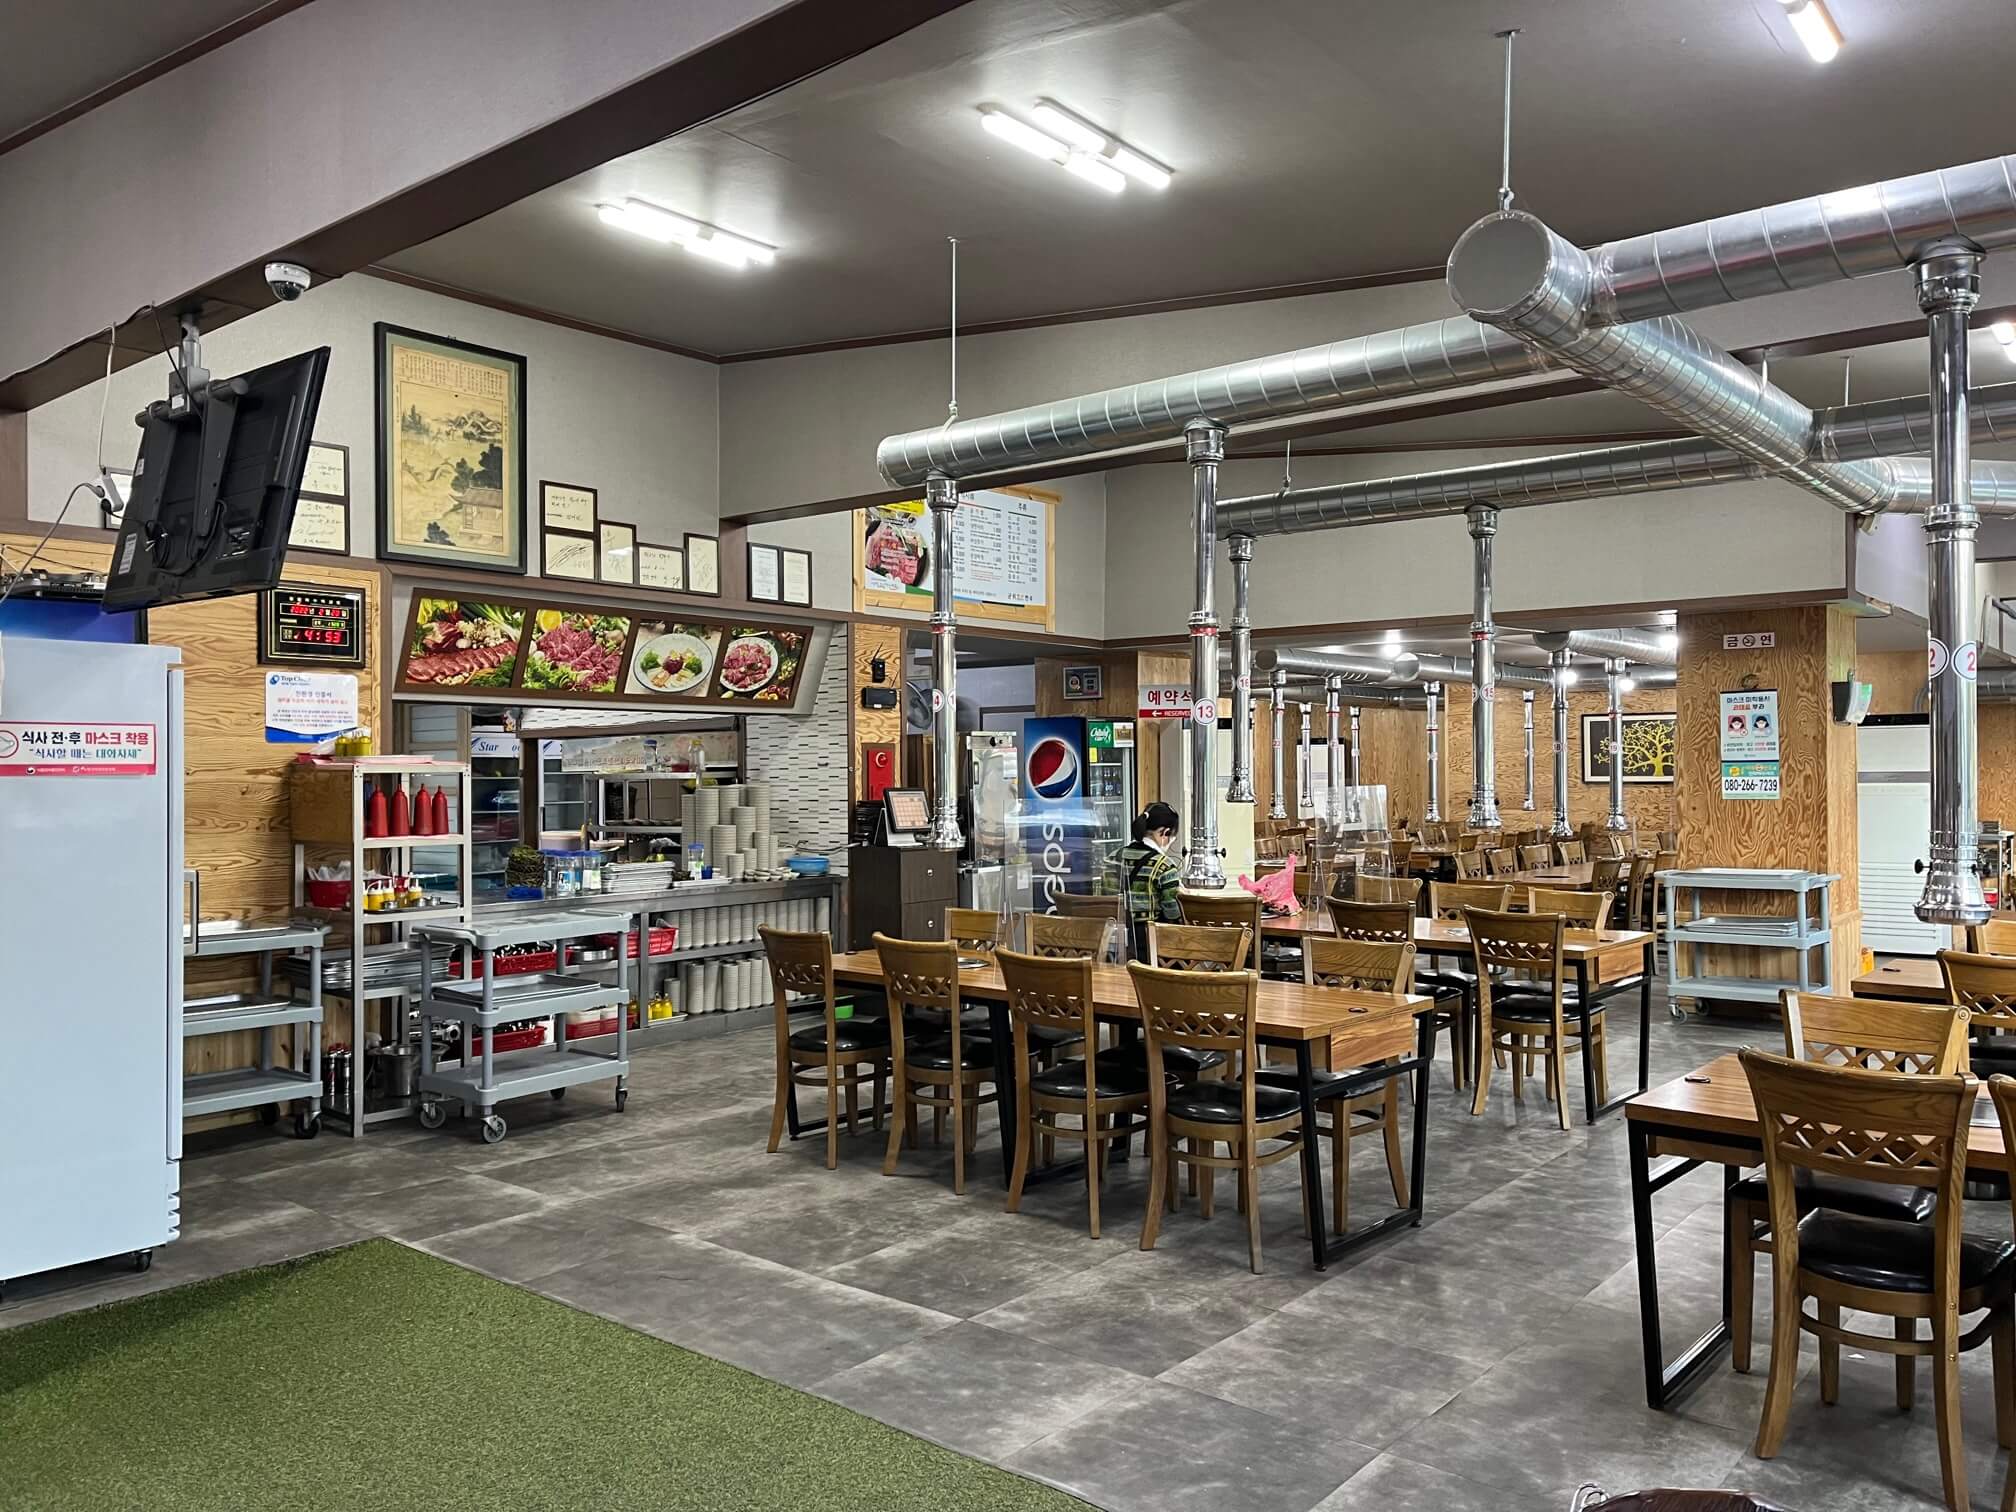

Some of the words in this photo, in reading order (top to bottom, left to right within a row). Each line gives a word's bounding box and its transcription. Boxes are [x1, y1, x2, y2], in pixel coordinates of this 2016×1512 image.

[1727, 636, 1739, 647] 금
[1760, 634, 1772, 646] 연
[1967, 651, 1976, 672] 2
[1198, 705, 1214, 718] 13
[22, 731, 47, 744] 식사
[51, 731, 81, 744] 전·후
[85, 732, 122, 745] 마스크
[125, 732, 149, 745] 착용
[478, 741, 499, 752] Star
[1724, 779, 1778, 791] 080-266-7239
[1043, 815, 1072, 914] eps
